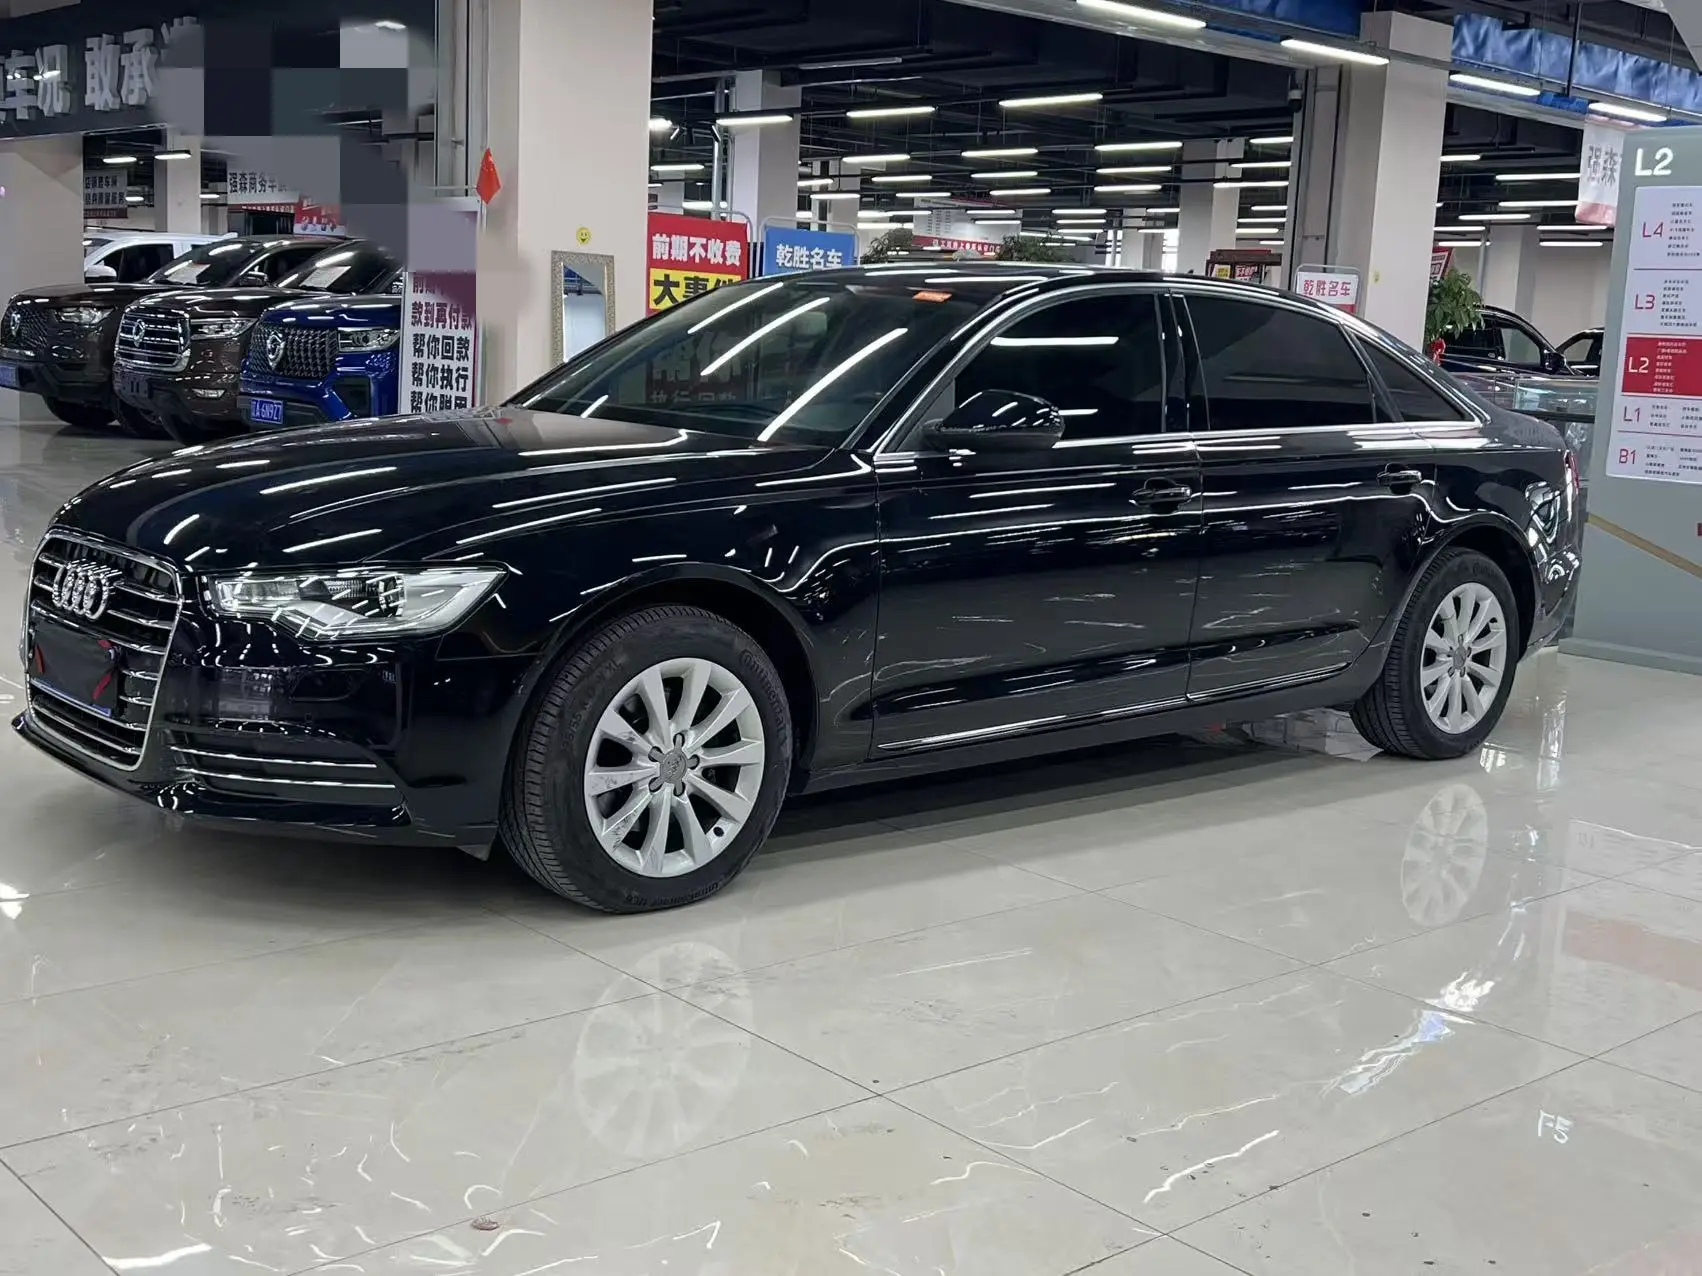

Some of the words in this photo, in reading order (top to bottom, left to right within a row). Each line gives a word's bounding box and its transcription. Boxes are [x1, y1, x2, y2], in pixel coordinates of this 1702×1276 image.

[0, 44, 71, 120] 车况
[1635, 147, 1674, 176] L2
[1642, 221, 1664, 238] L4
[652, 233, 742, 267] 前期不收费
[775, 243, 843, 269] 乾胜名车
[1303, 279, 1352, 297] 乾胜名车
[1634, 294, 1656, 310] L3
[412, 333, 471, 361] 帮你回款
[1628, 356, 1650, 374] L2
[411, 361, 469, 392] 帮你执行
[1623, 405, 1641, 422] L1
[1618, 448, 1637, 465] B1
